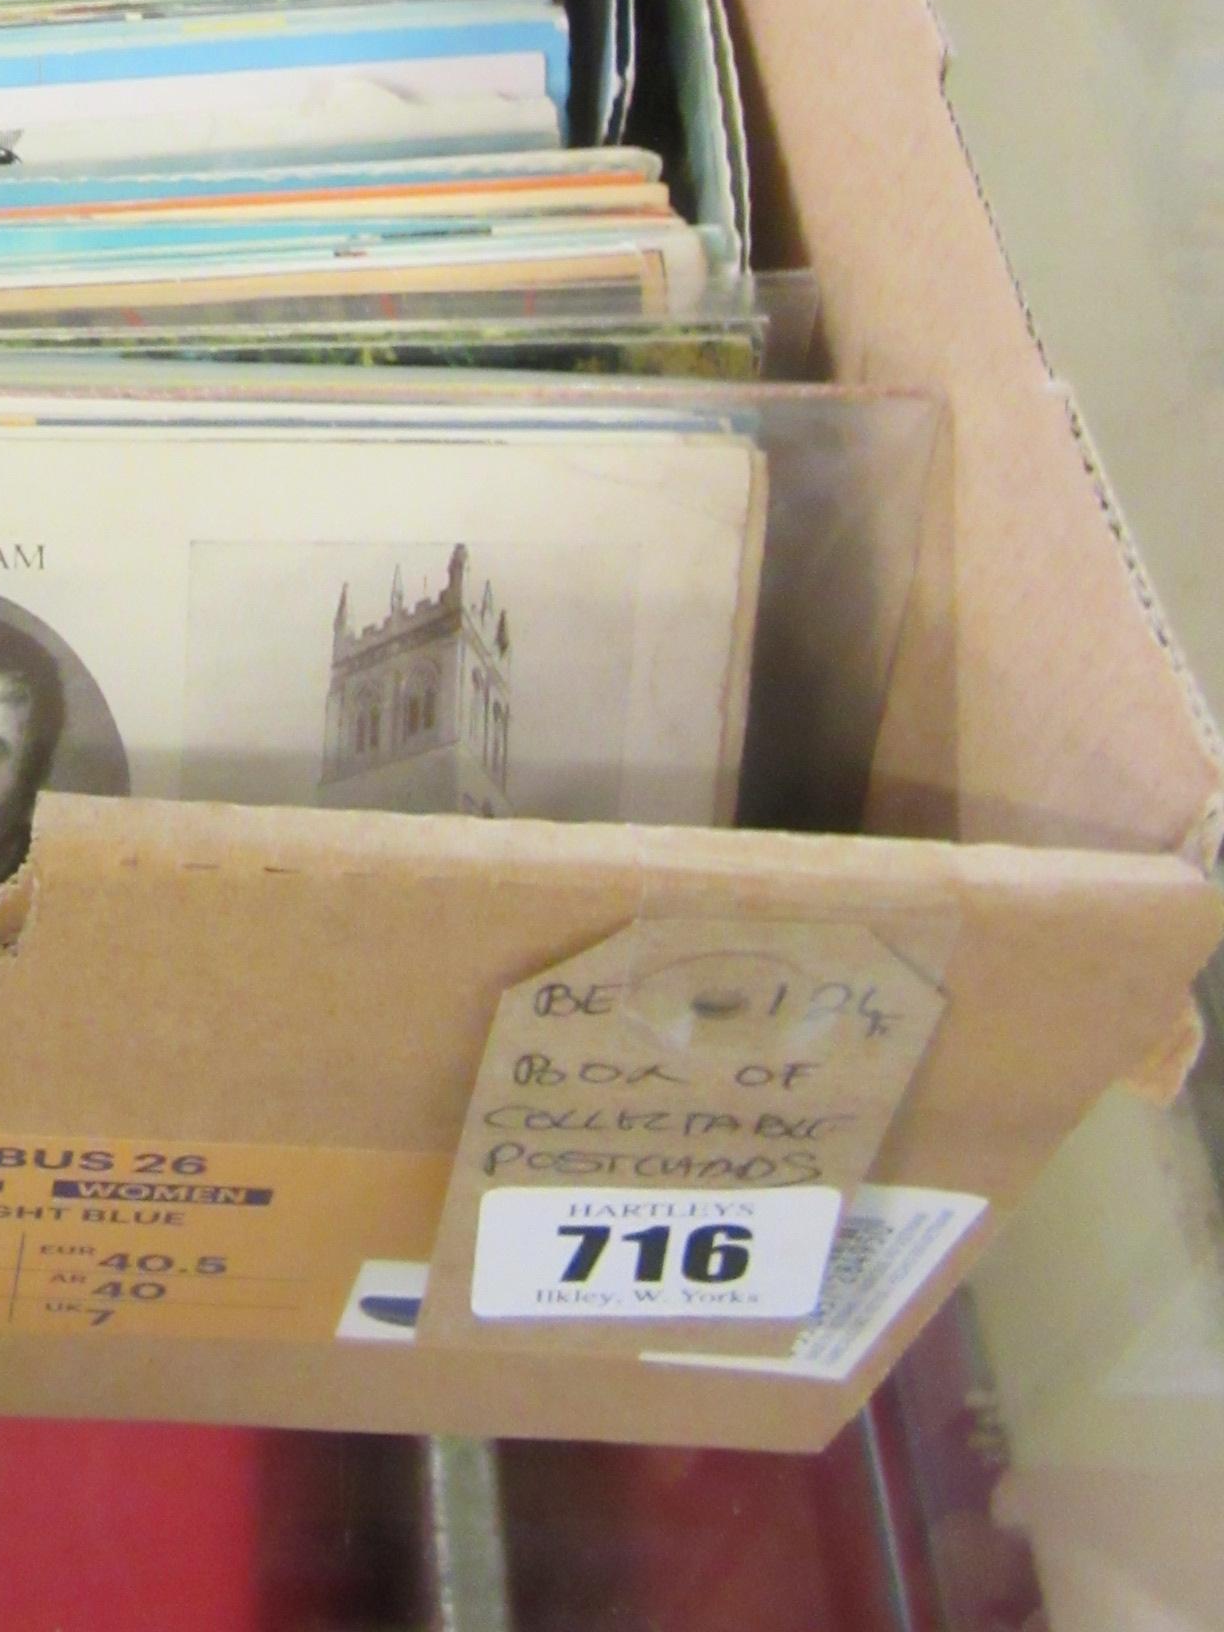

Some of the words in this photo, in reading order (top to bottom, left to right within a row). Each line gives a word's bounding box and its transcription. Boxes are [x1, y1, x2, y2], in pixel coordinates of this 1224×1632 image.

[735, 1063, 818, 1091] OF
[133, 1152, 209, 1176] 26
[76, 1182, 246, 1205] WOMEN
[80, 1207, 185, 1226] BLUE
[569, 1202, 755, 1218] HARTLEYS
[98, 1252, 228, 1275] 40.5
[557, 1224, 753, 1284] 716
[91, 1281, 167, 1300] 40
[680, 1289, 760, 1304] Yorks
[85, 1309, 115, 1327] 7
